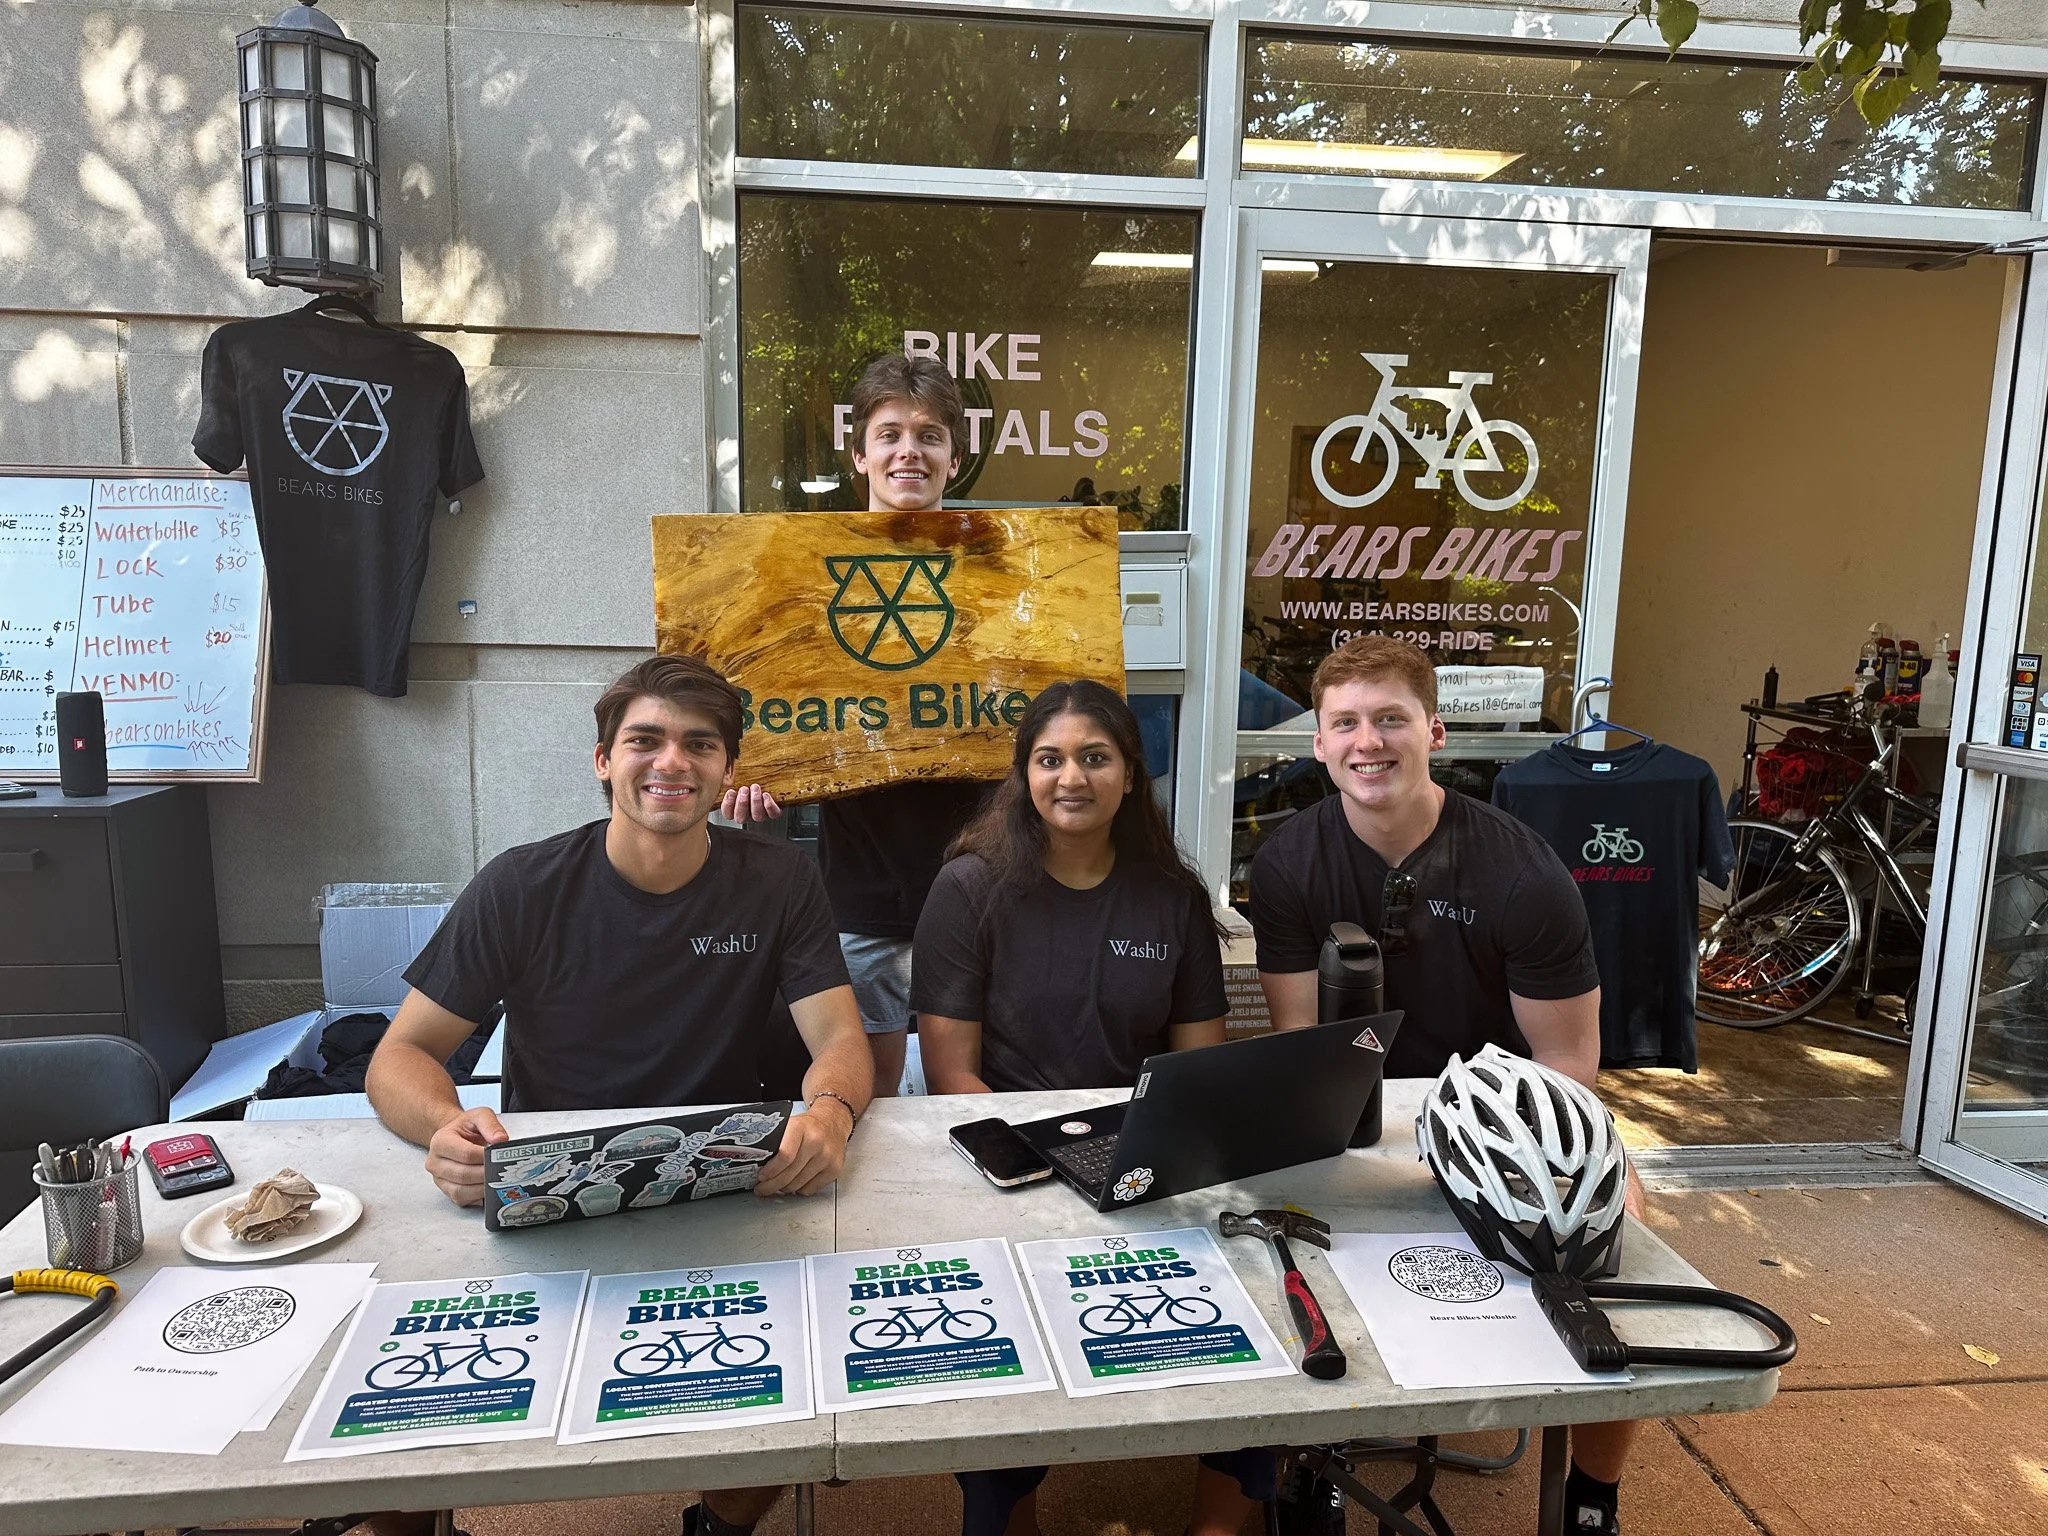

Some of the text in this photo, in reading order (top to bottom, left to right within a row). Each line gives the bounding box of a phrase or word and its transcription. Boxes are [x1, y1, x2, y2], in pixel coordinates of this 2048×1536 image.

[99, 483, 228, 502] Merchandise:
[278, 477, 384, 505] BEARS BIKES
[58, 521, 84, 534] $25
[95, 520, 243, 543] Waterbottle $5
[58, 549, 76, 560] $10
[1252, 524, 1582, 582] BEARS BIKES
[215, 553, 248, 573] $30
[209, 592, 241, 613] $15
[1280, 601, 1549, 623] WWW.BEARSBIKES.COM
[53, 621, 76, 633] $15
[84, 629, 232, 658] Helmet $20
[2020, 660, 2035, 668] VISA
[81, 671, 181, 696] VENMO:
[1439, 671, 1468, 686] mail
[1480, 672, 1494, 685] us
[909, 682, 1031, 729] Bike
[1437, 698, 1541, 714] arsBikes18@Gmail.com
[36, 725, 56, 738] $15
[37, 742, 54, 756] $10
[1613, 866, 1655, 882] BIKES
[689, 933, 758, 956] WashU
[1108, 939, 1168, 961] WashU
[1136, 1074, 1149, 1097] Lenovo
[496, 1141, 574, 1160] FOREST HILLS
[1066, 1247, 1180, 1269] BEARS
[855, 1258, 971, 1281] BEARS
[1064, 1261, 1197, 1288] BIKES
[637, 1281, 760, 1303] BEARS
[849, 1272, 983, 1301] BIKES
[408, 1290, 537, 1314] BEARS
[626, 1296, 768, 1325] BIKES
[390, 1307, 541, 1336] BIKES
[1120, 1338, 1178, 1347] CONVENIENTLY
[885, 1352, 944, 1361] CONVENIENTLY
[1135, 1359, 1217, 1371] WWW.BEARSBIKES.COM
[134, 1365, 155, 1373] Path
[168, 1368, 218, 1377] Ownership
[894, 1373, 978, 1385] WWW.BEARSBIKES.COM
[643, 1379, 706, 1389] CONVENIENTLY
[348, 1399, 388, 1407] LOCATED
[388, 1393, 455, 1403] CONVENIENTLY
[645, 1402, 735, 1415] WWW.BEARSBIKES.COM
[361, 1420, 398, 1428] RESERVE
[382, 1418, 477, 1430] WWW.BEARSBIKES.COM
